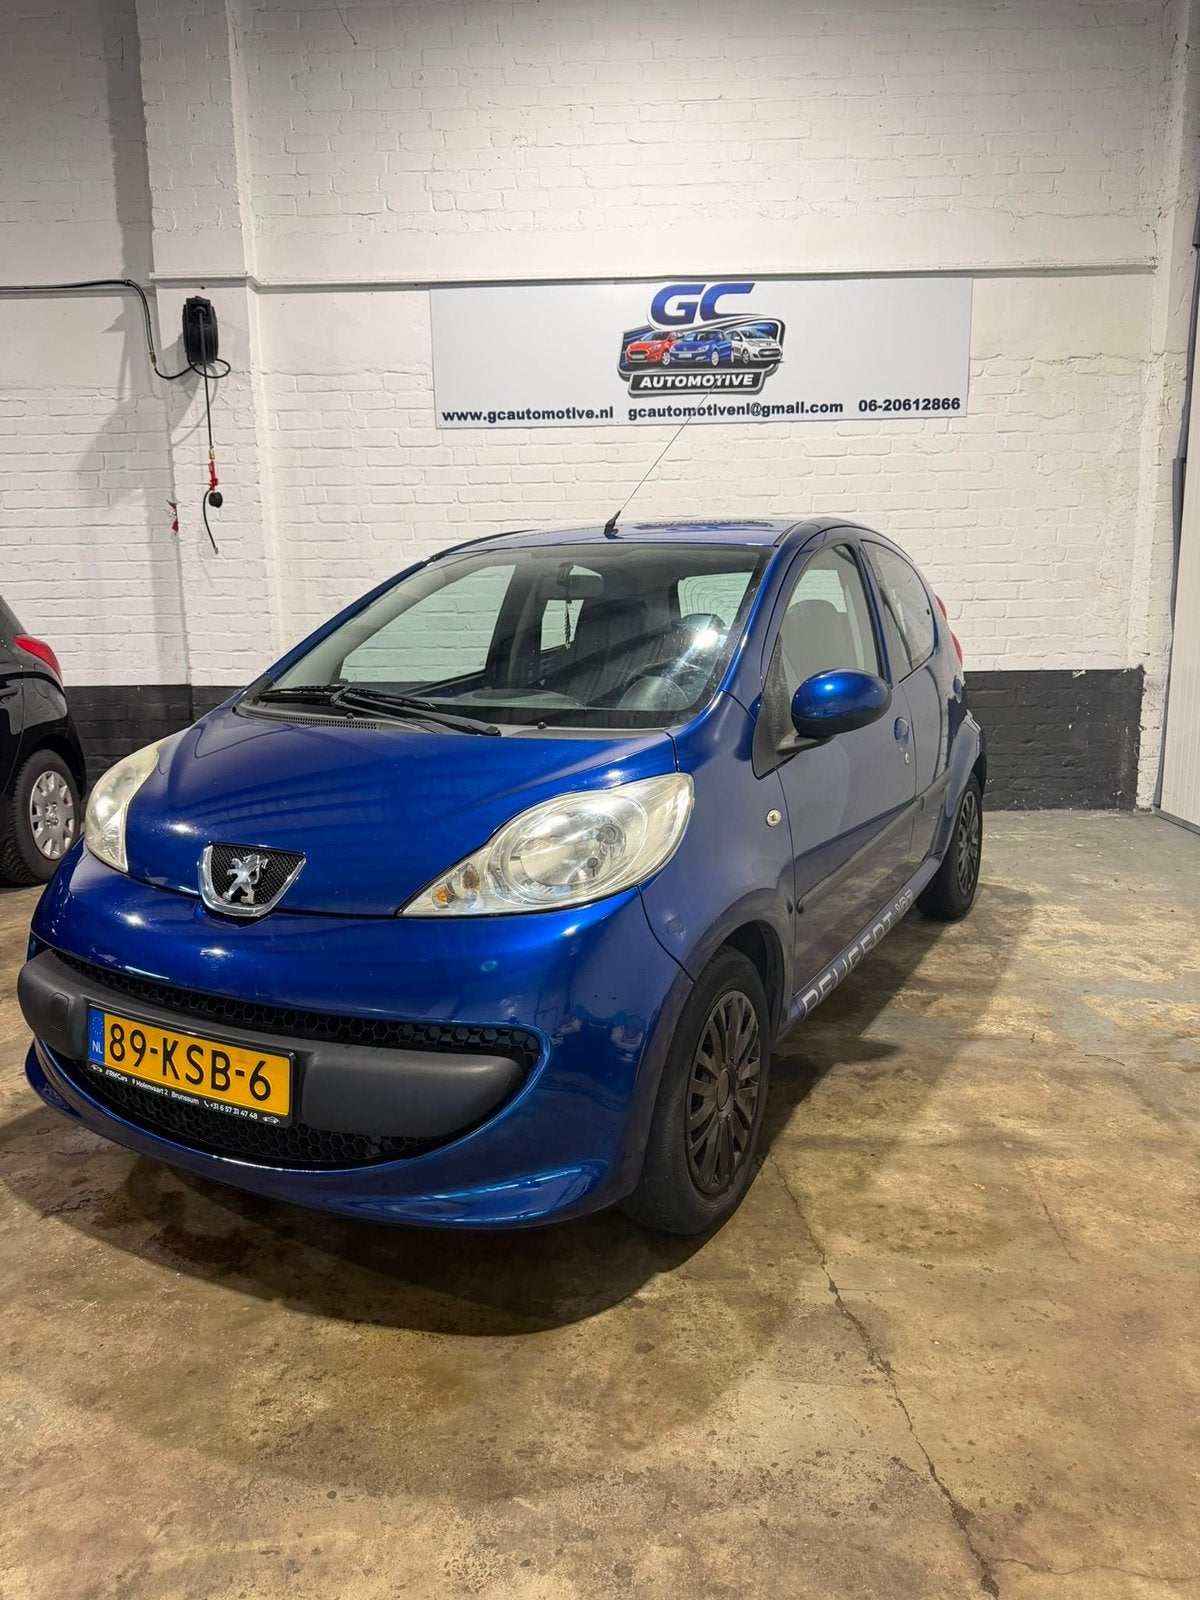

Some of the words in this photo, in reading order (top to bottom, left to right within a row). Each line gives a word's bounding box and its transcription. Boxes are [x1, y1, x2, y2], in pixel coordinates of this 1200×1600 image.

[651, 283, 755, 326] GC
[639, 374, 753, 388] AUTOMOTIVE
[442, 406, 614, 423] www.gcautomotive.nl
[628, 401, 843, 420] gcautomotivenl@gmail.com
[858, 398, 961, 412] 06-20612866
[92, 1040, 103, 1054] NL
[109, 1023, 272, 1102] 89-KSB-6
